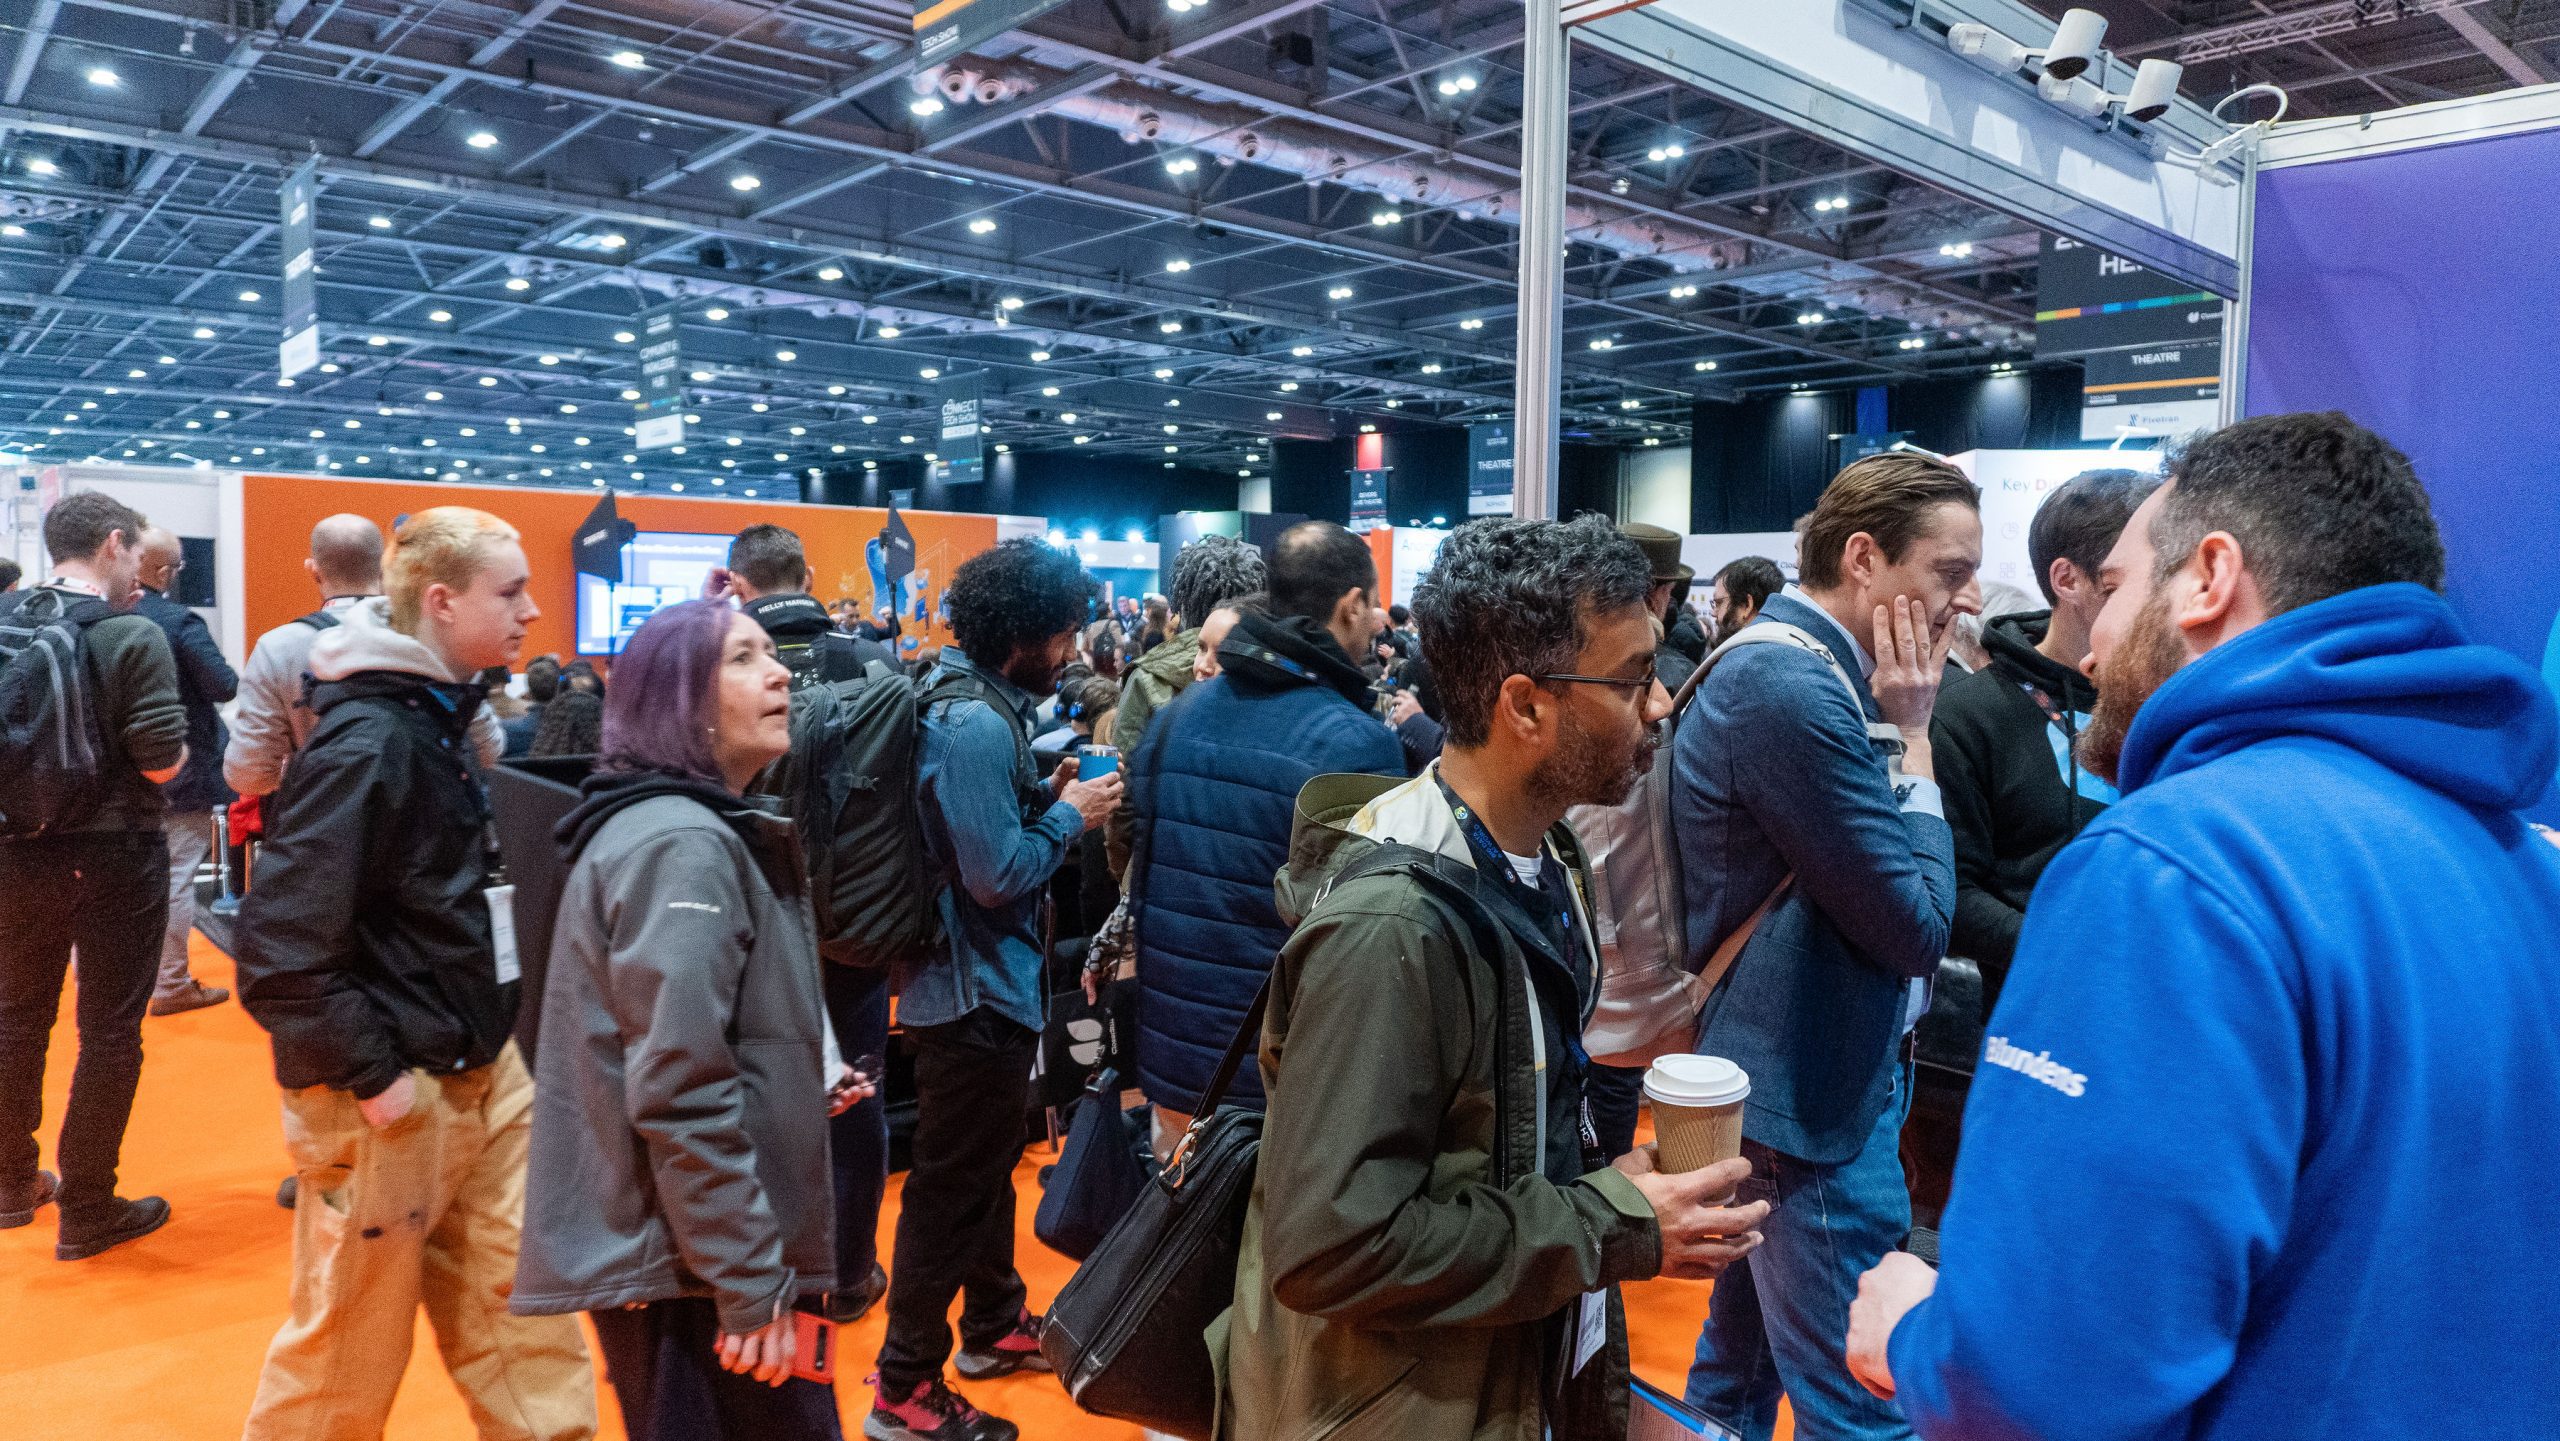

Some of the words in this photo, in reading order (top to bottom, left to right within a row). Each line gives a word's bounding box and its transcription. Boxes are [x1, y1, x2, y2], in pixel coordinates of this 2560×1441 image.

[2100, 253, 2143, 276] HE
[2131, 351, 2181, 365] THEATRE
[942, 399, 978, 416] CONNECT
[2141, 414, 2180, 424] Fivetran
[1477, 459, 1512, 471] THEATRE
[2003, 479, 2030, 493] Key
[757, 601, 784, 614] HELLY
[785, 599, 815, 607] HANSEN
